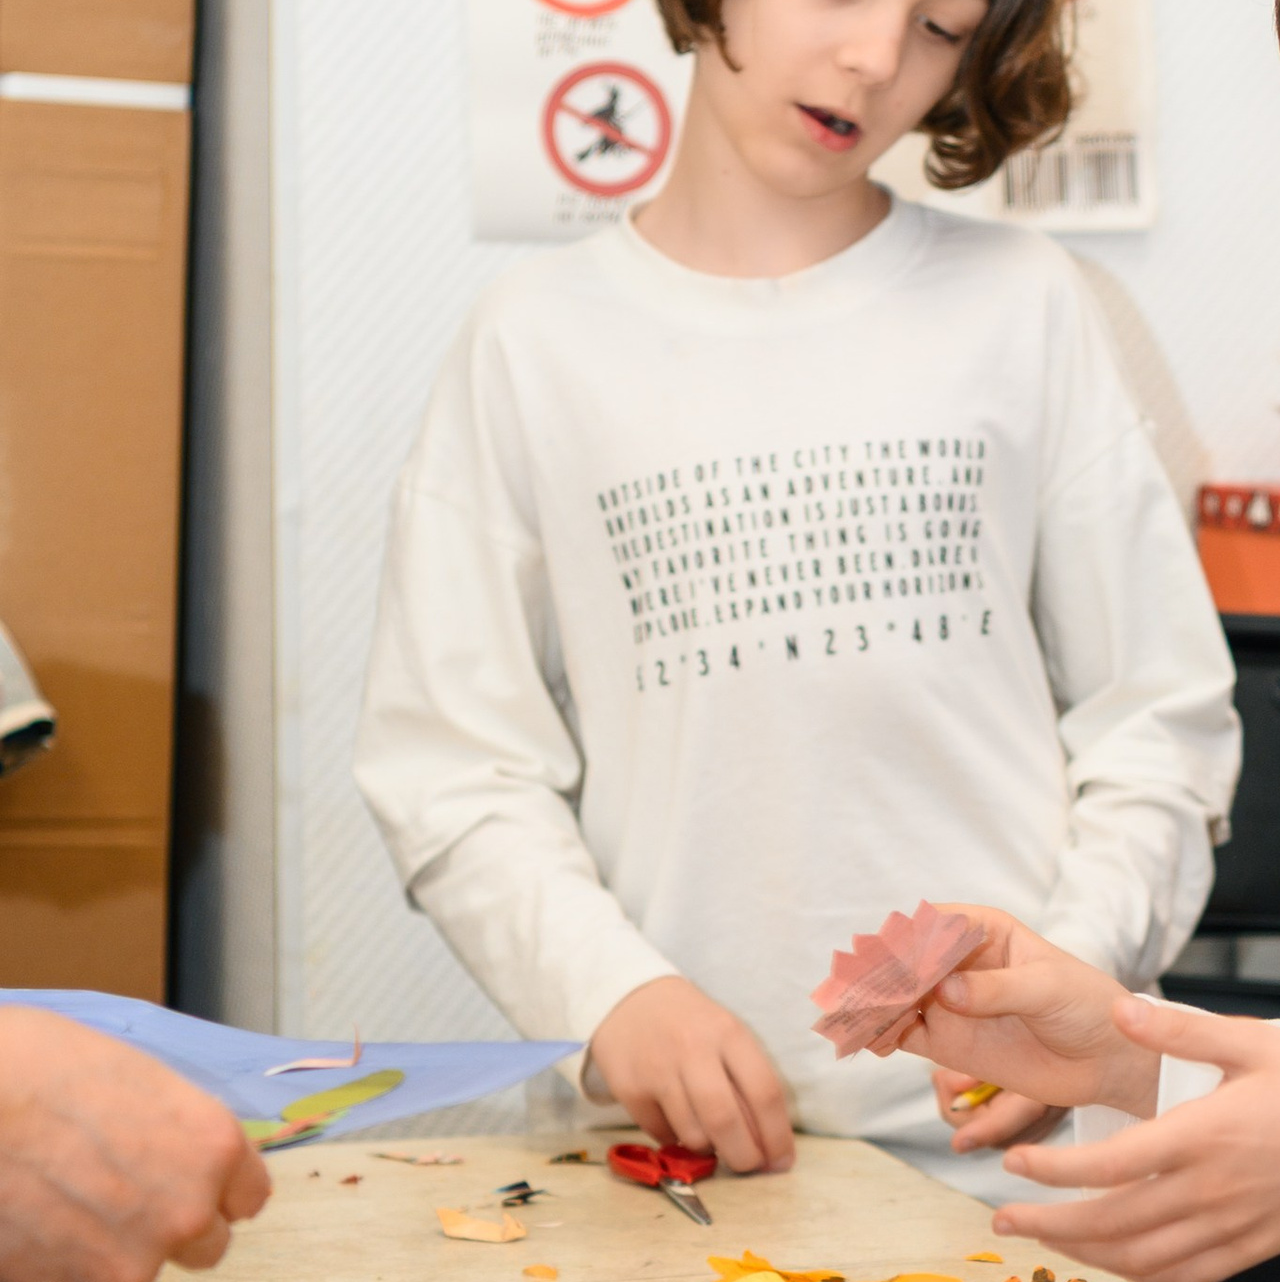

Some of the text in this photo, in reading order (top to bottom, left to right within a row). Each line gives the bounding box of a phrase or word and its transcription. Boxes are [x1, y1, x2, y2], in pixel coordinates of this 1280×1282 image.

[598, 439, 985, 511] OUTSIDE OF THE CITY THE WORLD
[605, 494, 690, 537] UNFOLDS
[705, 486, 730, 508] AS
[743, 483, 769, 502] AN
[952, 466, 984, 486] AND
[836, 494, 888, 519] JUST
[652, 537, 768, 579] FAVORITE
[788, 524, 865, 553] THING
[884, 522, 907, 542] IS
[925, 519, 981, 539] GONG
[748, 558, 821, 587] NEVER
[714, 590, 803, 624] EXPAND
[814, 581, 871, 607] YOUR
